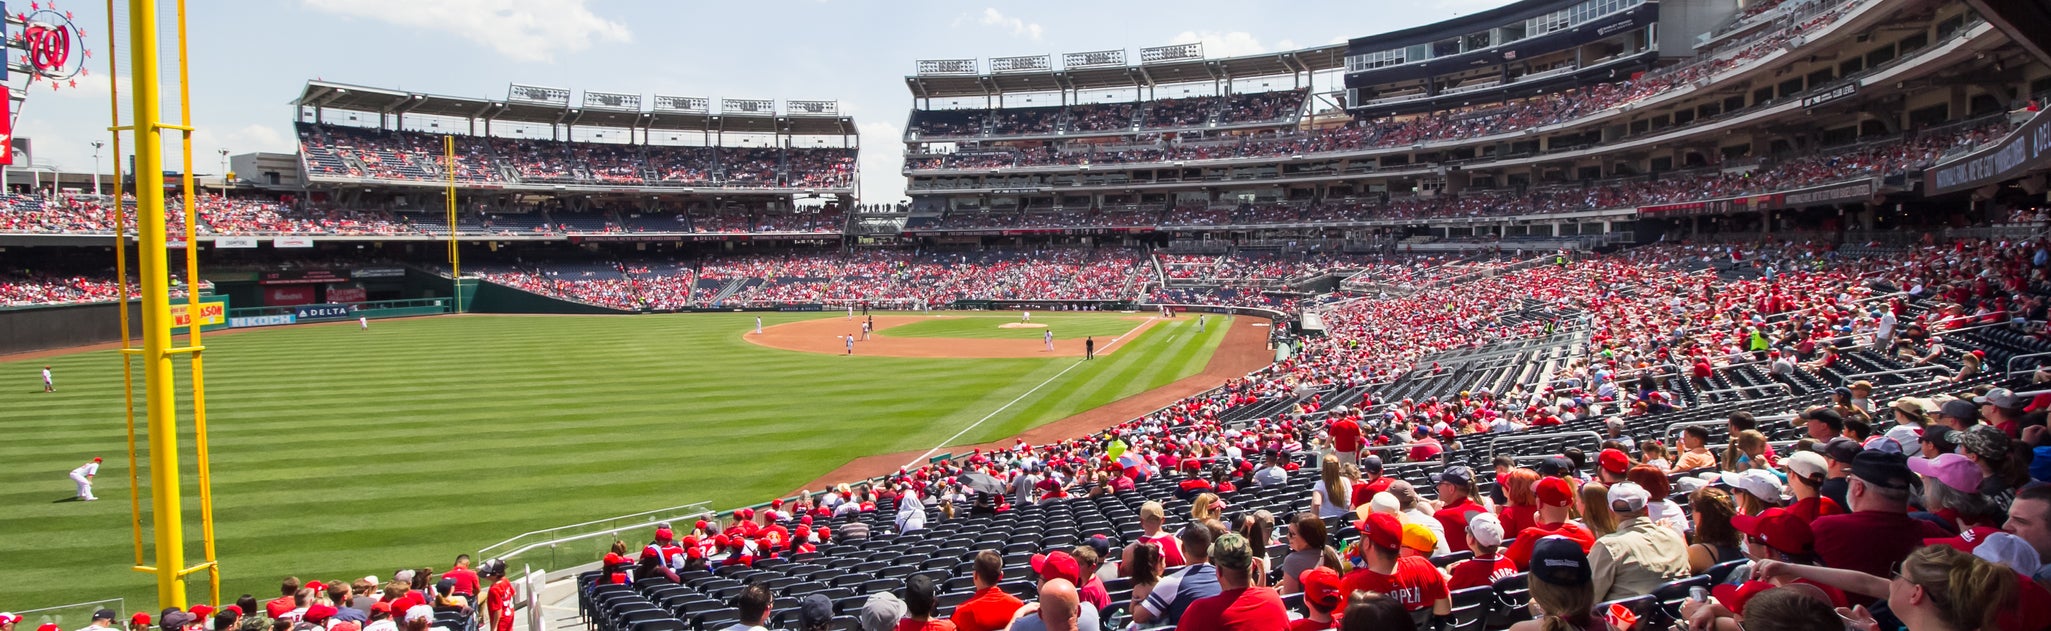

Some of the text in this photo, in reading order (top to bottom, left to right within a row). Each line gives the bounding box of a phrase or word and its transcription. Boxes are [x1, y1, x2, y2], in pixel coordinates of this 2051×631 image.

[201, 305, 222, 317] ASON
[310, 308, 346, 316] DELTA
[248, 315, 291, 326] KOCH
